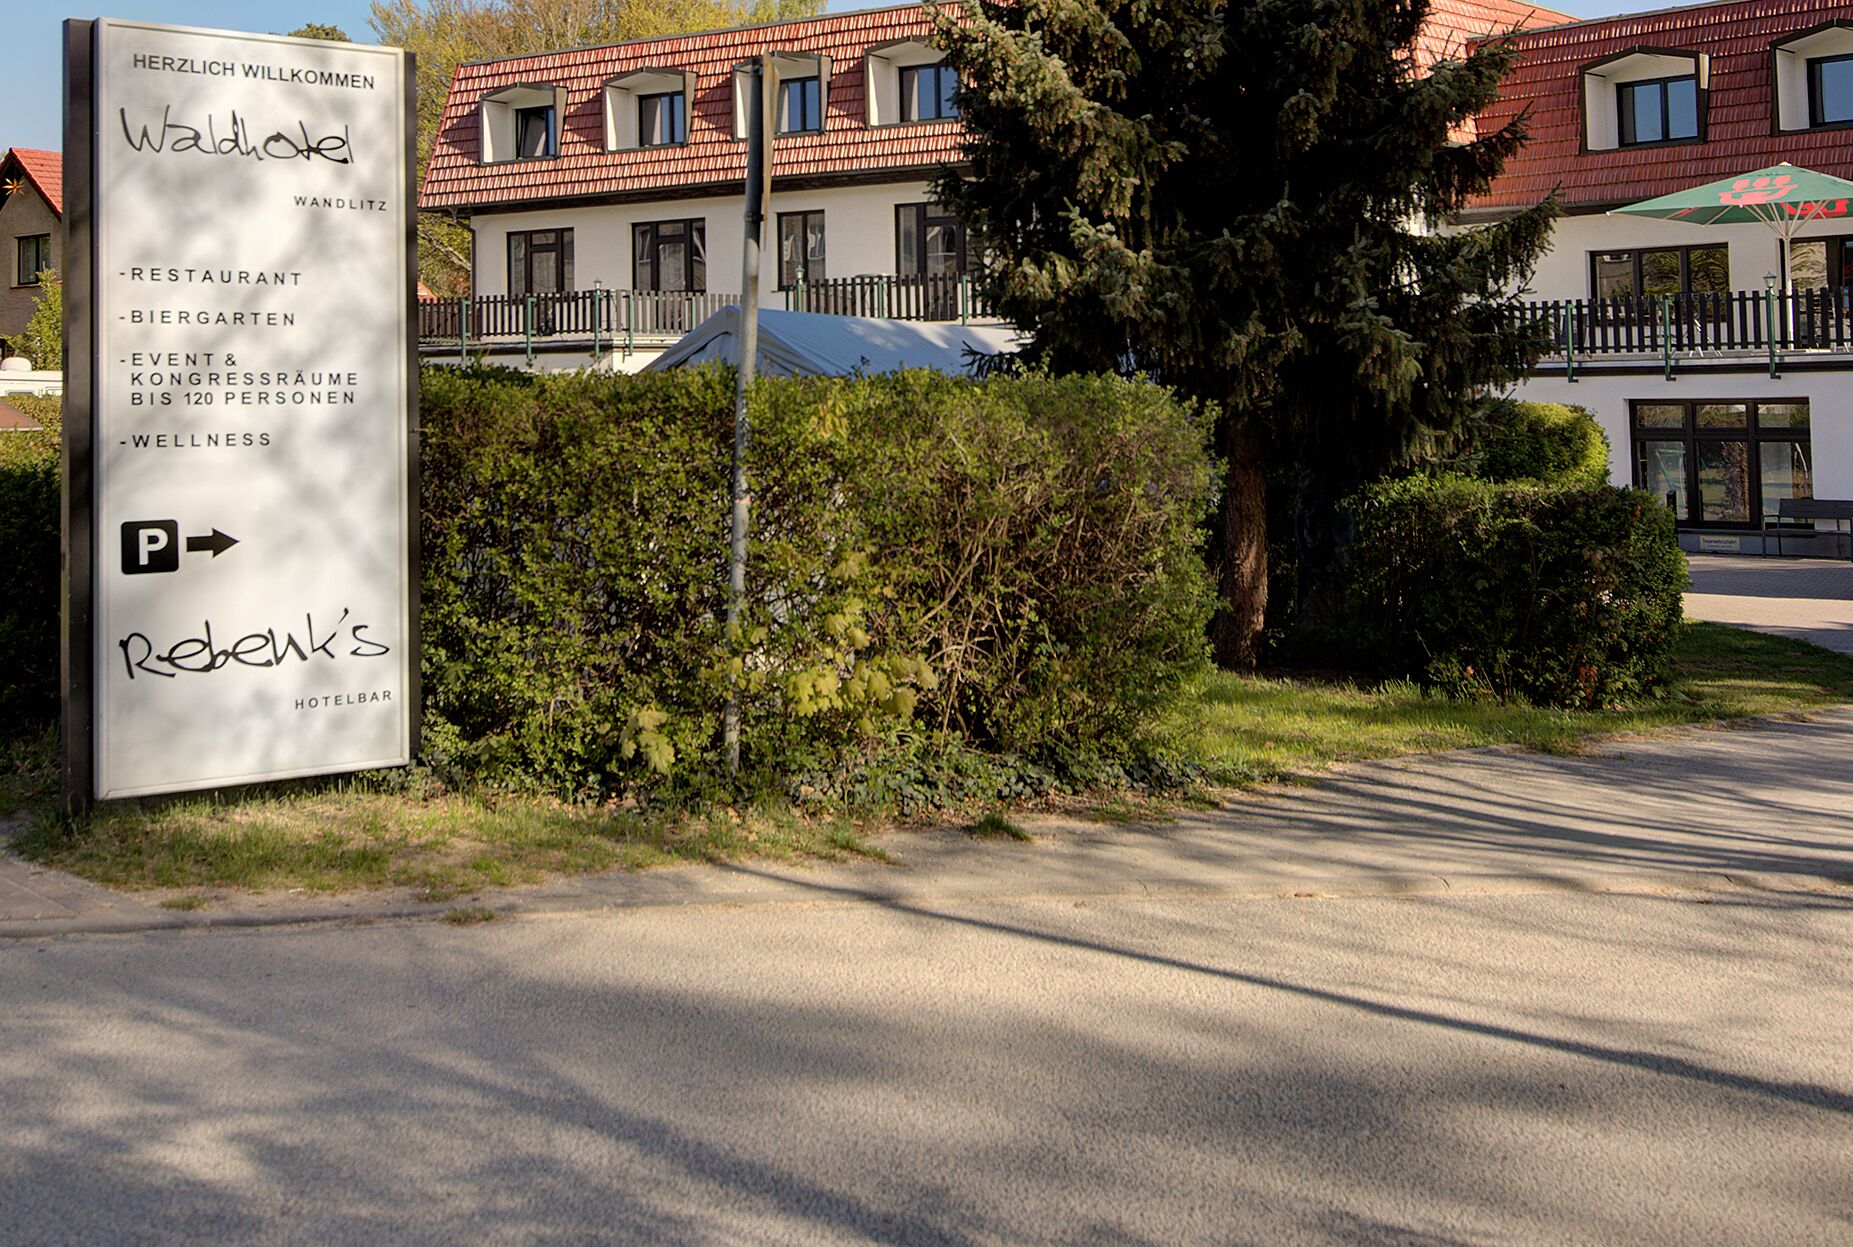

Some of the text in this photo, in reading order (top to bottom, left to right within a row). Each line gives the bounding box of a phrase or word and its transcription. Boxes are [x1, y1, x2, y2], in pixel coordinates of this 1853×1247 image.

[133, 53, 375, 90] HERZLICH WILLKOMMEN
[119, 104, 355, 165] Waldhotel
[293, 195, 387, 212] WANDLITZ
[224, 352, 237, 367] &
[130, 369, 358, 388] KONGRESSRÄUME
[131, 390, 354, 406] BIS 120 PERSONEN
[138, 527, 169, 566] P
[295, 690, 392, 710] HOTELBAR
